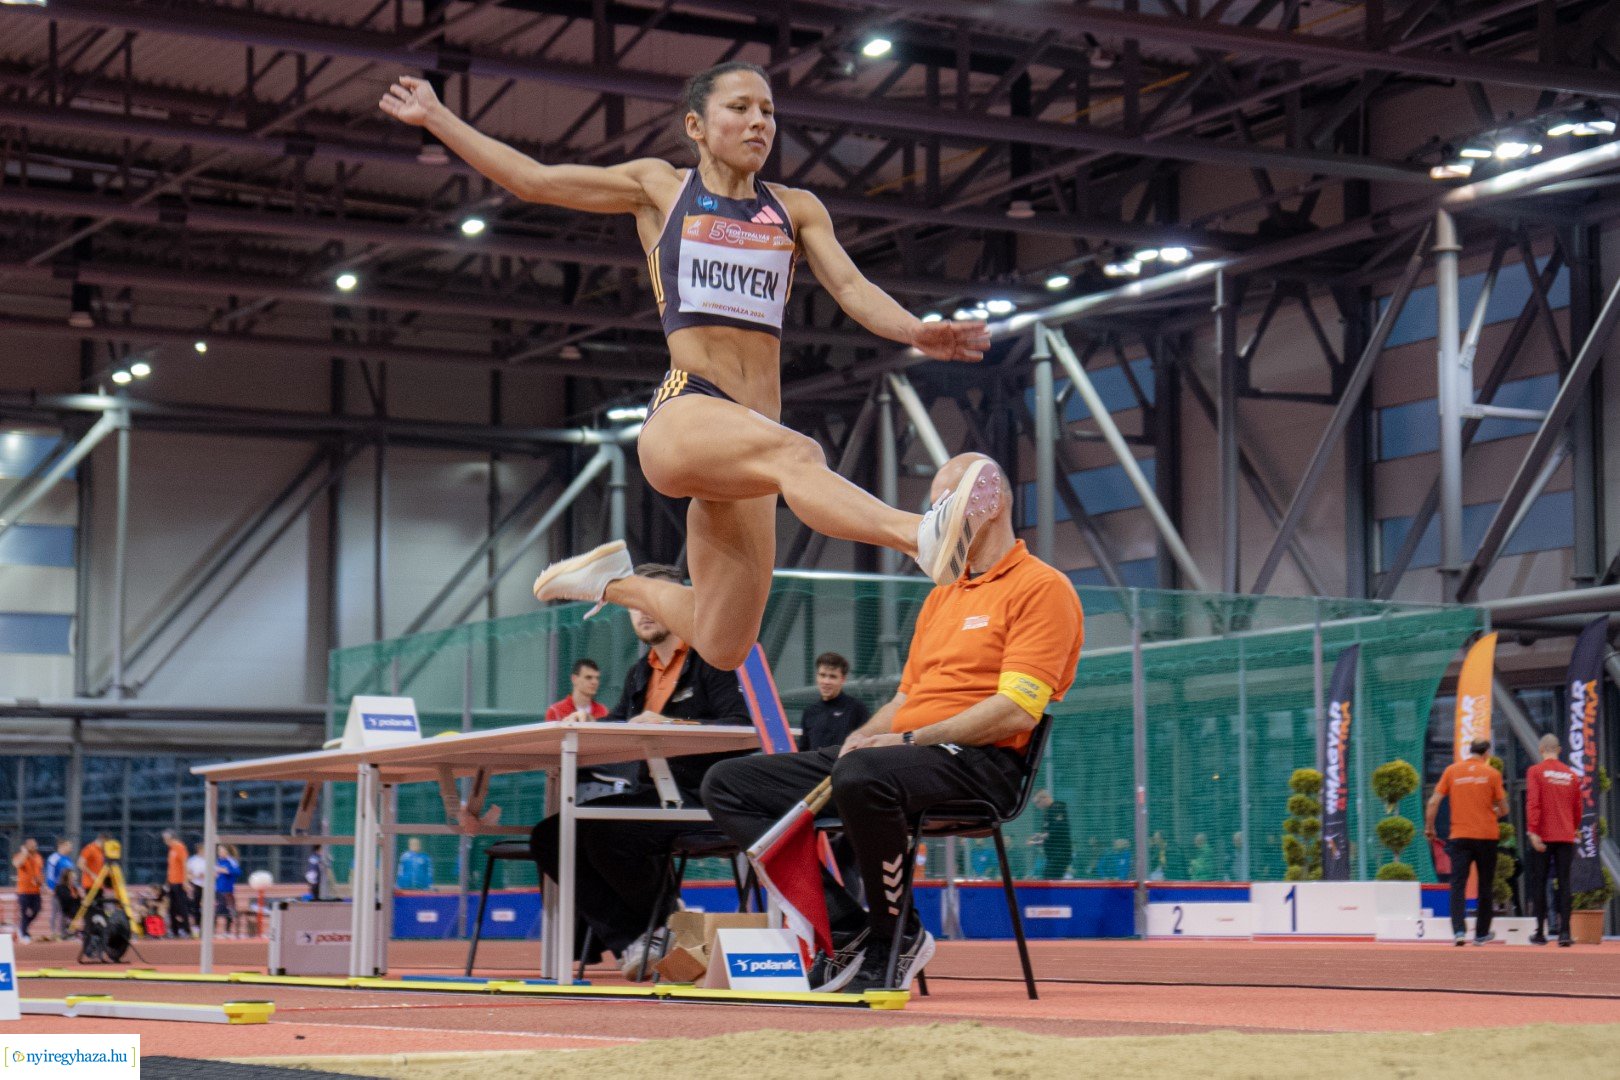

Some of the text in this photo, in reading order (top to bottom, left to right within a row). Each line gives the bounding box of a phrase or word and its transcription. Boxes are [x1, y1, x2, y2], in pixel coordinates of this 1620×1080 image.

[691, 258, 779, 301] NGUYEN
[1172, 905, 1184, 935] 2
[1284, 885, 1297, 932] 1
[1416, 920, 1426, 938] 3
[750, 959, 797, 973] polanik
